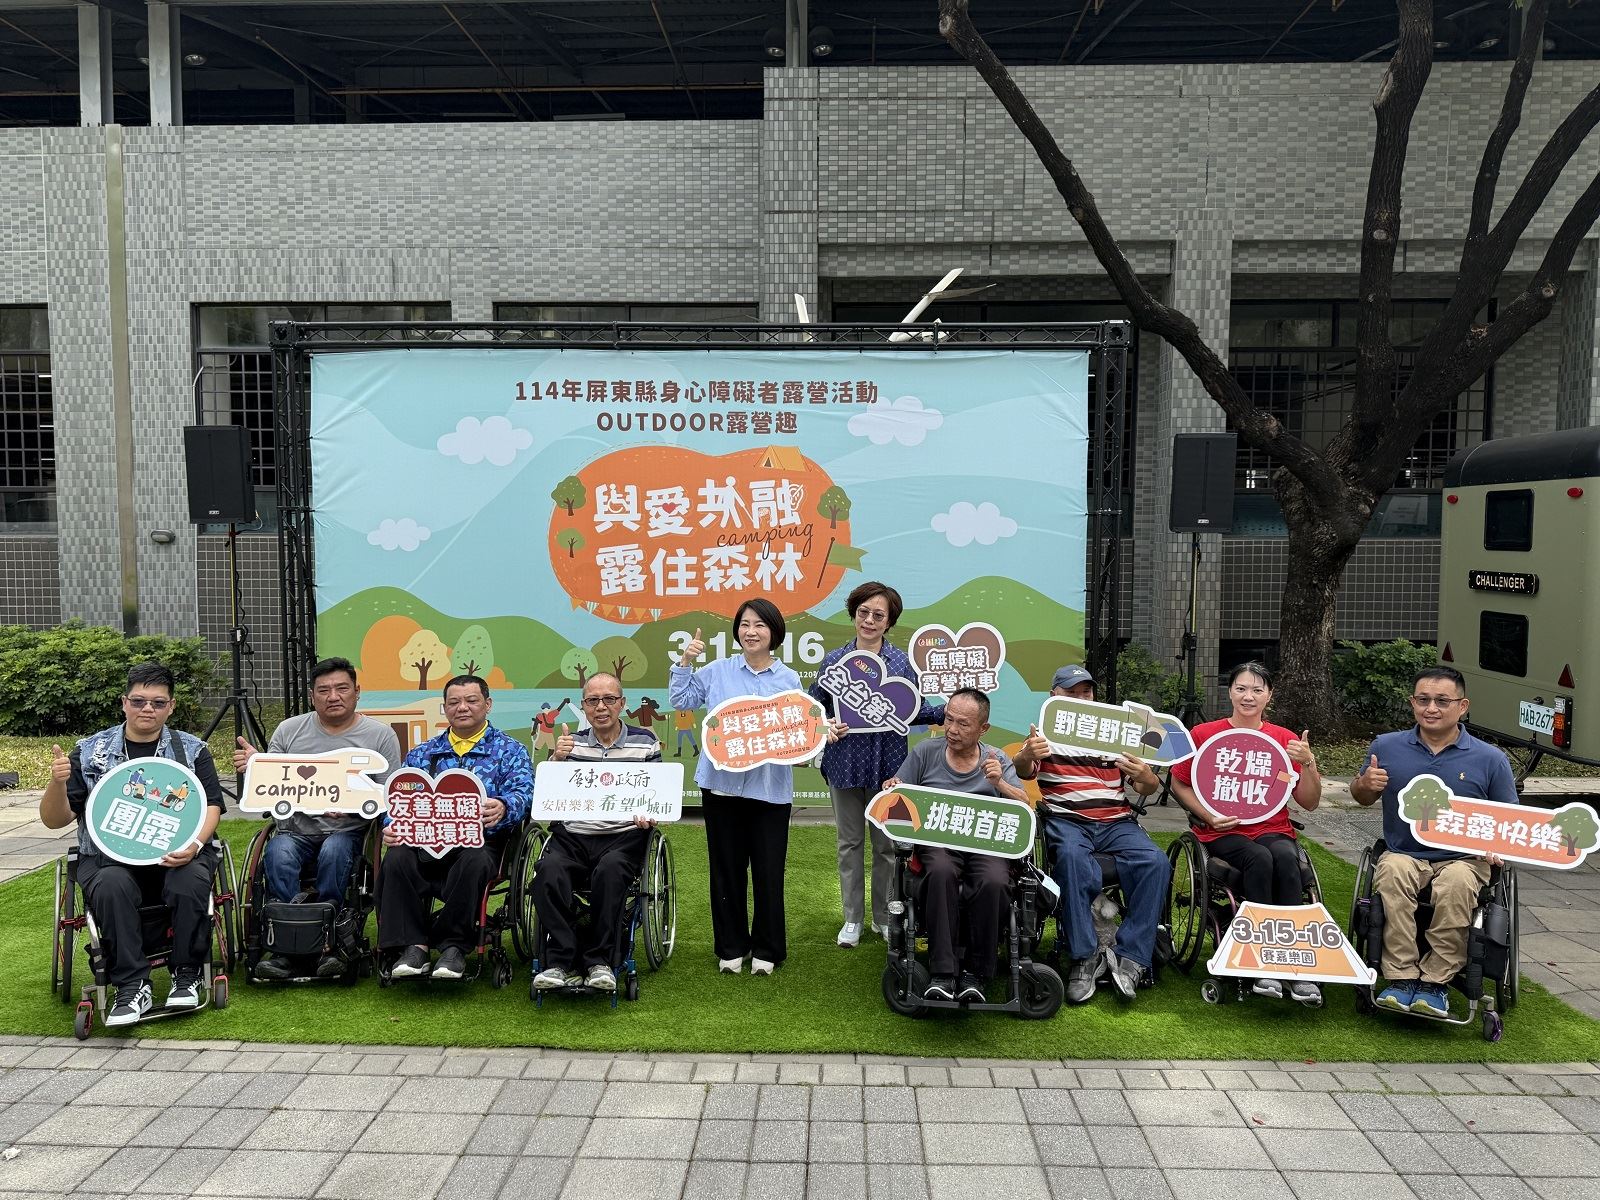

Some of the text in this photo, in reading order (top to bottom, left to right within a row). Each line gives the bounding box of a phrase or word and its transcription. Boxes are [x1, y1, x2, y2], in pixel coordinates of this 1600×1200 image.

[515, 379, 878, 404] 114年屏東縣身心障礙者露營活動
[597, 410, 798, 435] OUTDOOR露營趣
[594, 476, 805, 537] 與愛共融
[716, 523, 814, 560] camping
[595, 542, 805, 597] 露住森林
[1475, 574, 1525, 590] CHALLENGER
[668, 630, 825, 664] 3.116
[929, 650, 987, 670] 無障礙
[922, 671, 997, 694] 露營拖車
[821, 668, 909, 734] 全台第一
[725, 727, 808, 759] 露住森林
[1053, 709, 1144, 748] 野營野宿
[281, 765, 291, 781] I
[1214, 746, 1272, 778] 乾燥
[255, 781, 341, 804] camping
[390, 795, 479, 818] 友善無礙
[542, 799, 595, 812] 安居樂業
[1212, 774, 1271, 807] 撤收
[99, 797, 181, 851] 團露
[392, 821, 480, 844] 共融環境
[923, 801, 1021, 844] 挑戰首露
[1434, 808, 1563, 852] 森露快樂
[1232, 916, 1342, 949] 3.15-16
